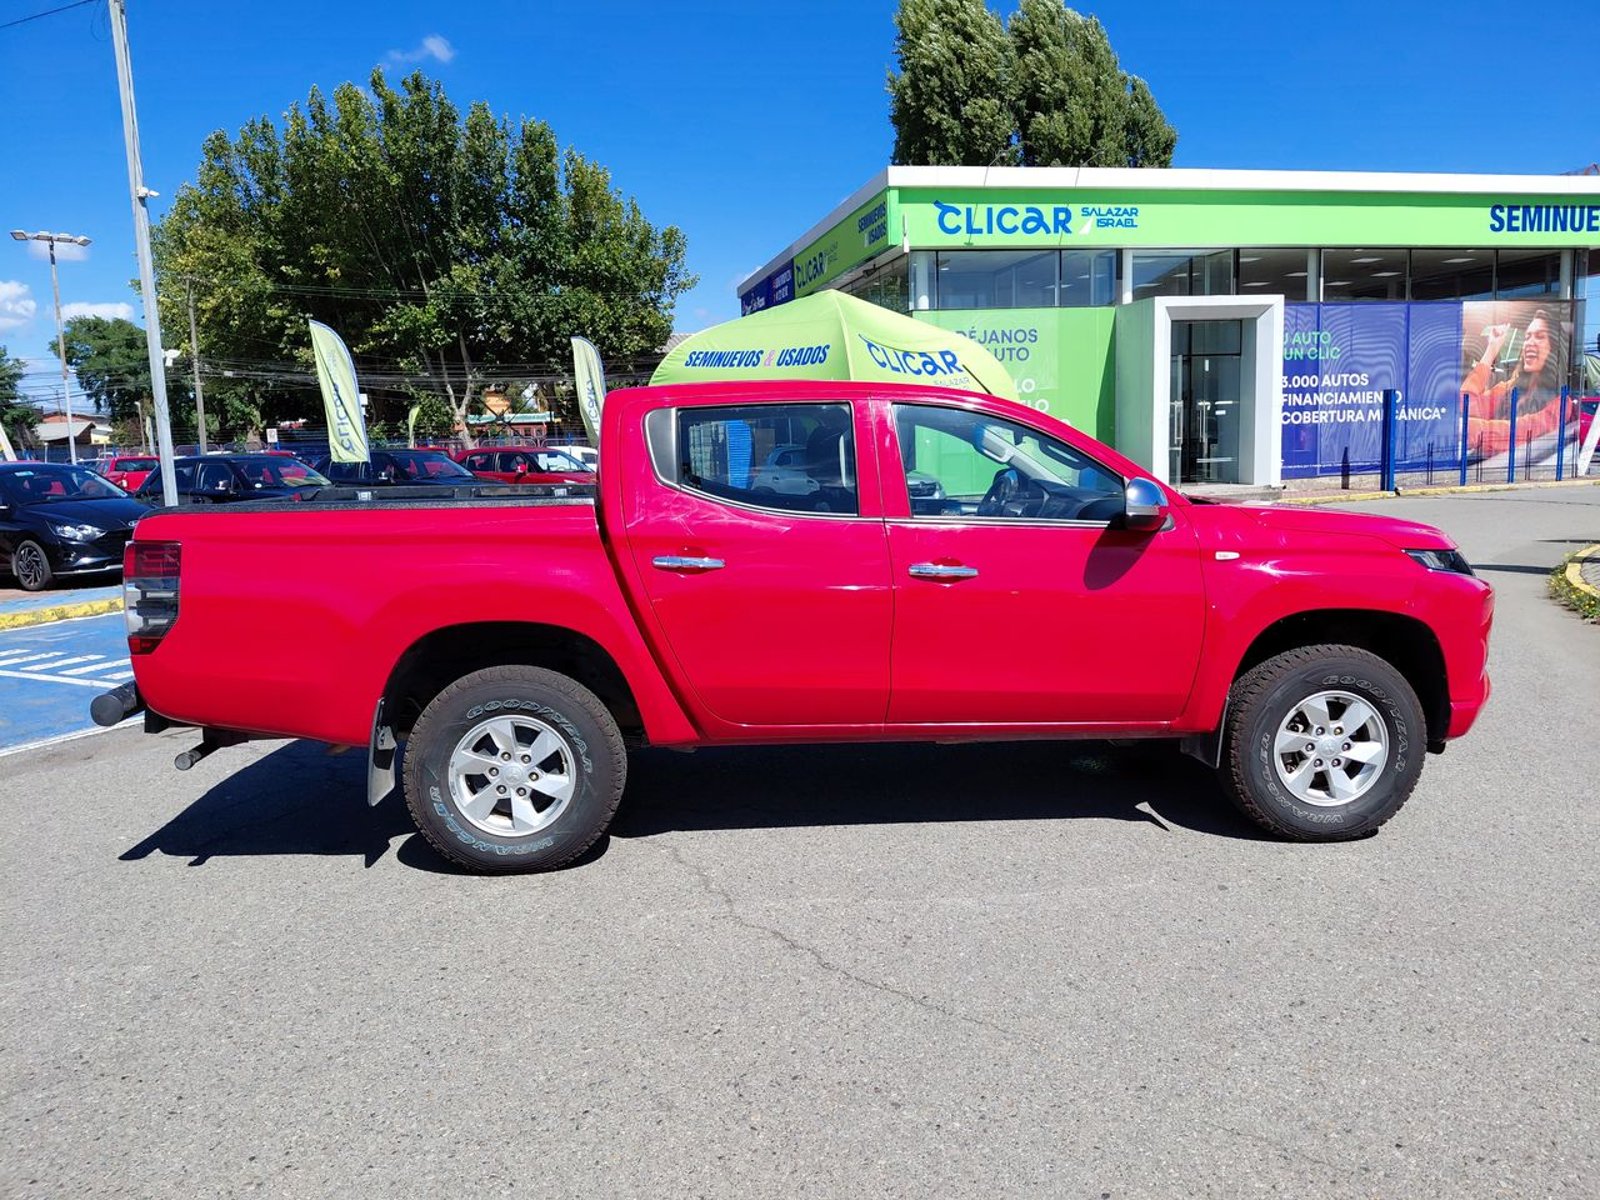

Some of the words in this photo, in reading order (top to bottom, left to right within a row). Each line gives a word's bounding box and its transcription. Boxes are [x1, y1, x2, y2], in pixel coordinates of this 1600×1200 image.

[1081, 207, 1139, 217] SALAZAR
[1490, 204, 1600, 232] SEMINUE
[1096, 218, 1139, 228] ISRAEL
[1292, 332, 1331, 345] AUTO
[685, 349, 764, 368] SEMINUEVOS
[776, 344, 831, 367] USADOS
[986, 347, 1029, 362] UTO
[1307, 347, 1341, 361] CLIC
[1321, 373, 1369, 387] AUTOS
[1282, 390, 1403, 406] FINANCIAMIENO
[1281, 410, 1365, 425] COBERTURA
[1322, 675, 1408, 772] GOODYEAR
[466, 700, 593, 774] GOODYEAR
